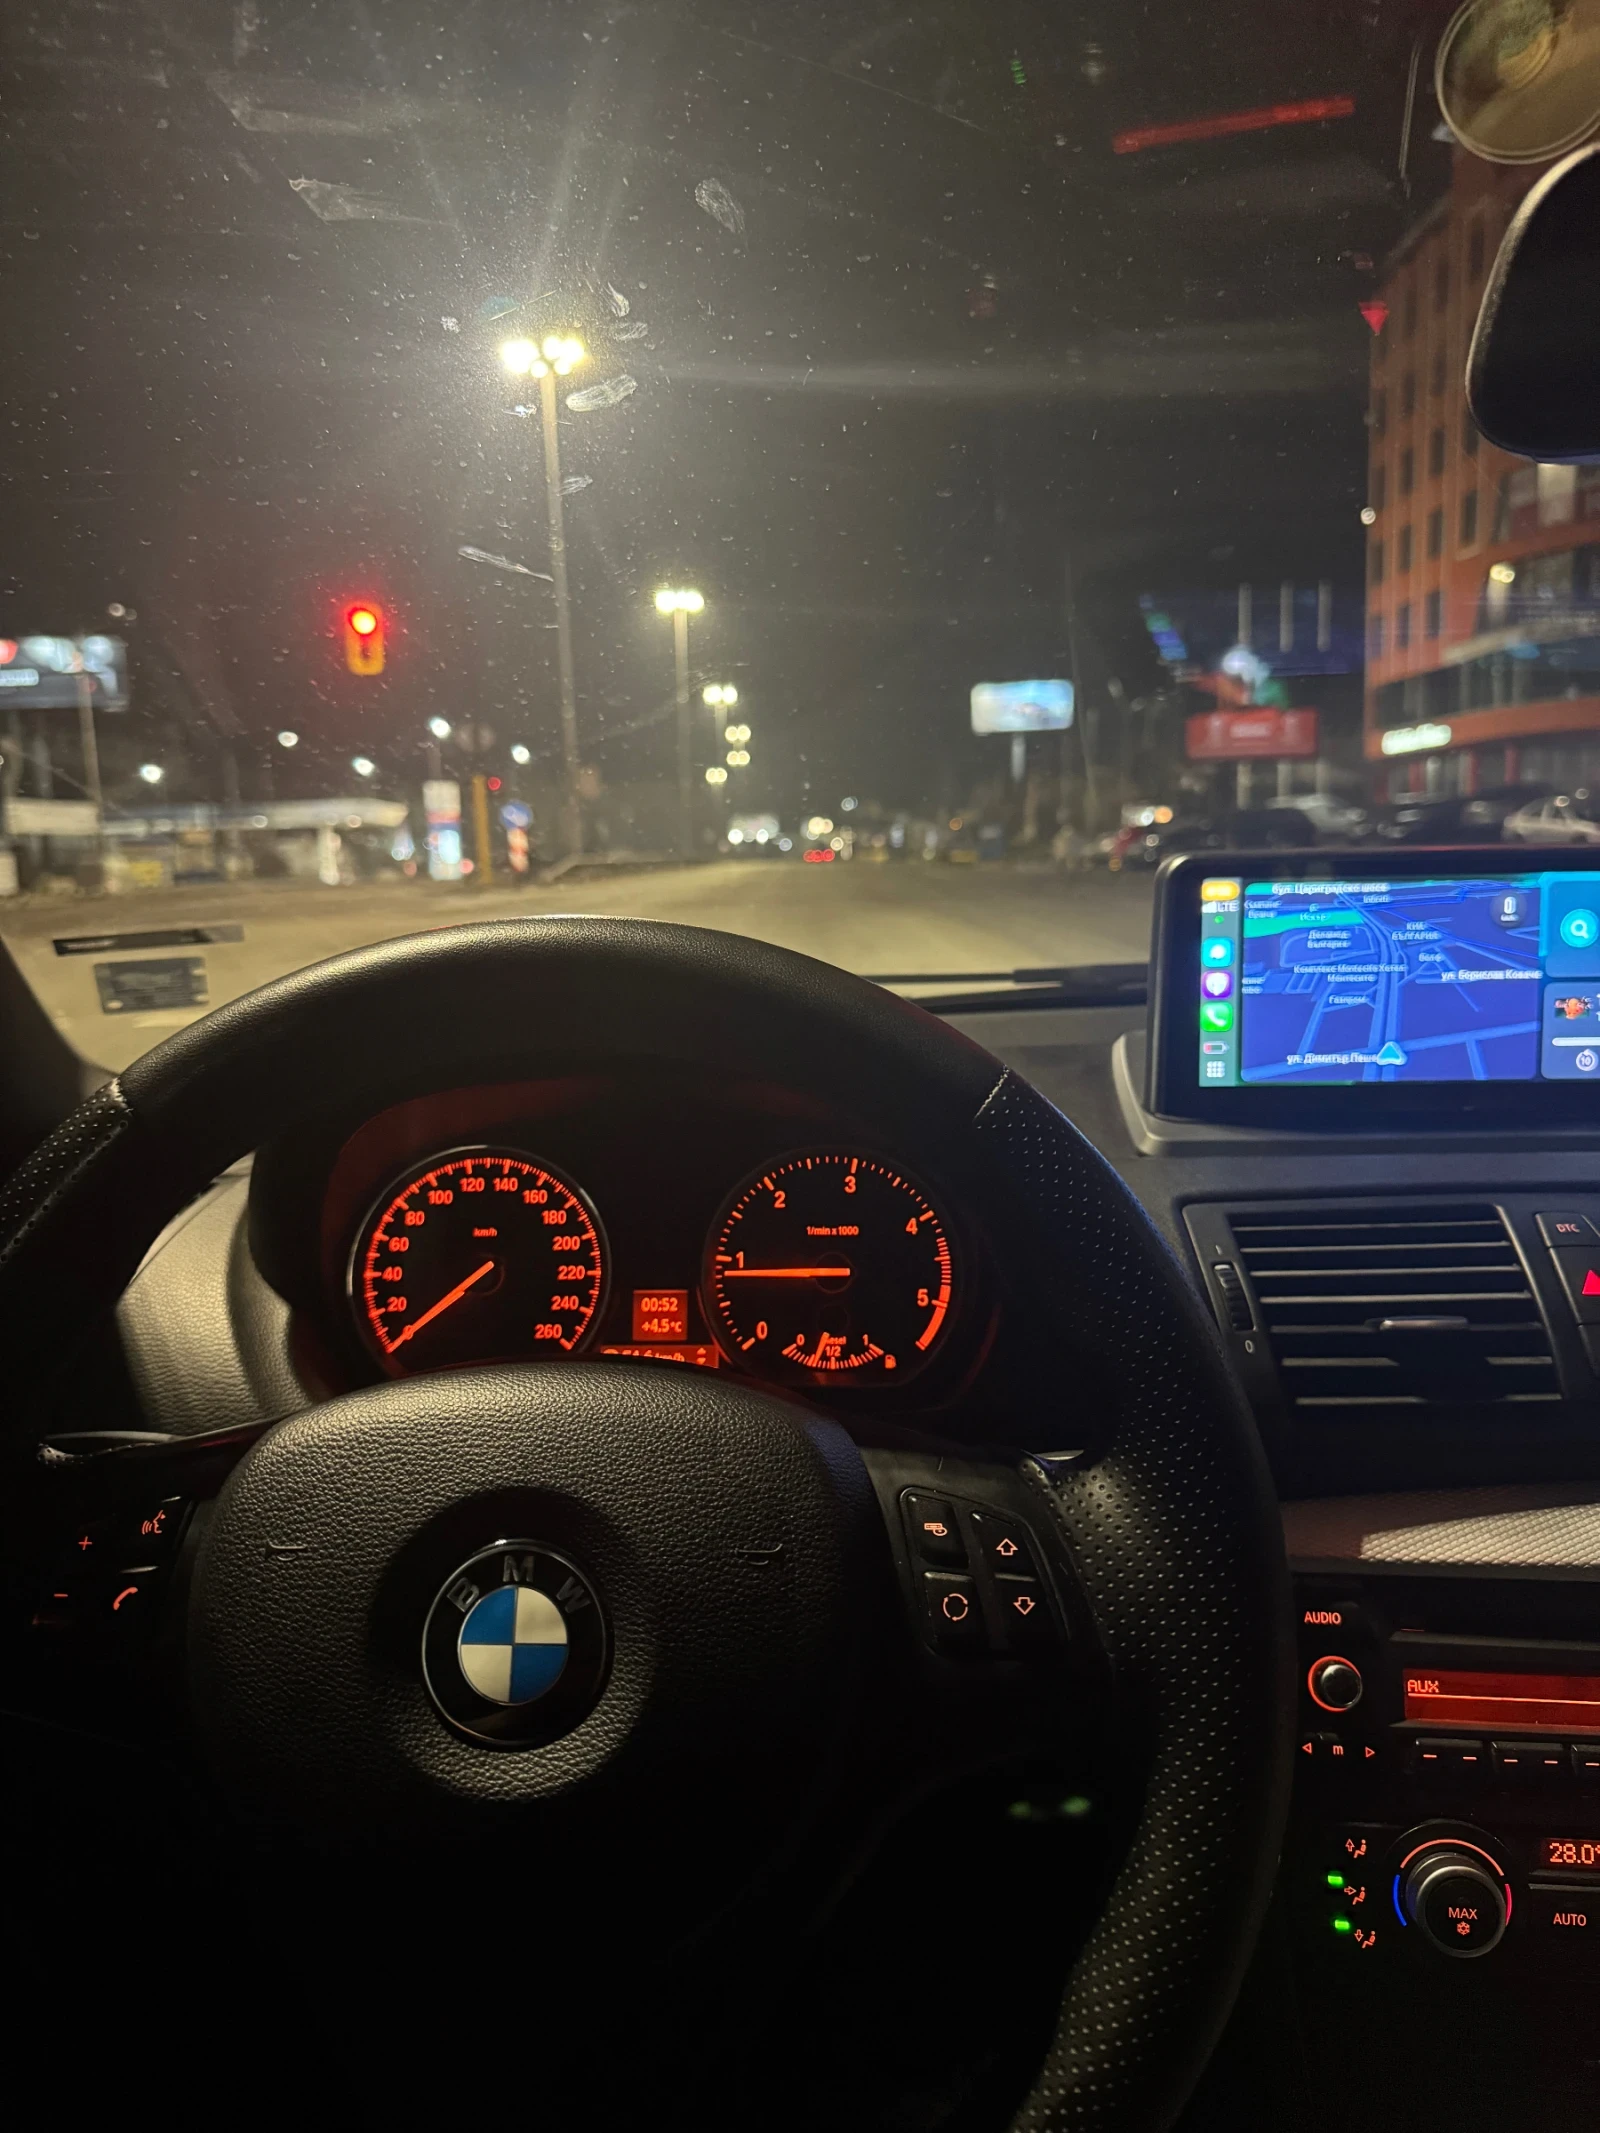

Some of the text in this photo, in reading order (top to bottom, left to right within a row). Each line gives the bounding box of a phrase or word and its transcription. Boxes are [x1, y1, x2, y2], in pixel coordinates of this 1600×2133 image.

[1218, 901, 1239, 912] LTE
[1504, 897, 1516, 914] 0
[460, 1177, 485, 1193] 120
[493, 1177, 518, 1192] 140
[844, 1175, 857, 1193] 3
[427, 1189, 453, 1205] 100
[522, 1189, 548, 1205] 160
[773, 1190, 786, 1209] 2
[404, 1210, 425, 1226] 80
[541, 1209, 567, 1225] 180
[473, 1226, 498, 1238] km/h
[807, 1225, 831, 1236] 1/min
[838, 1225, 859, 1236] 1000
[905, 1217, 918, 1235] 4
[1555, 1223, 1580, 1233] DTC
[388, 1236, 409, 1252] 60
[552, 1235, 580, 1251] 200
[735, 1251, 745, 1269] 1
[382, 1265, 403, 1281] 40
[557, 1264, 585, 1280] 220
[387, 1296, 407, 1312] 20
[551, 1295, 579, 1311] 240
[641, 1297, 678, 1312] 00:52
[916, 1288, 929, 1306] 5
[534, 1323, 562, 1339] 260
[642, 1318, 682, 1333] +4.5°C
[756, 1321, 768, 1340] 0
[796, 1333, 806, 1346] 0
[862, 1333, 869, 1346] 1
[825, 1345, 842, 1357] 1/2
[446, 1555, 591, 1614] BMW
[1304, 1611, 1341, 1625] AUDIO
[1407, 1679, 1440, 1693] AUX
[1448, 1906, 1478, 1920] MAX
[1553, 1912, 1587, 1927] AUTO
